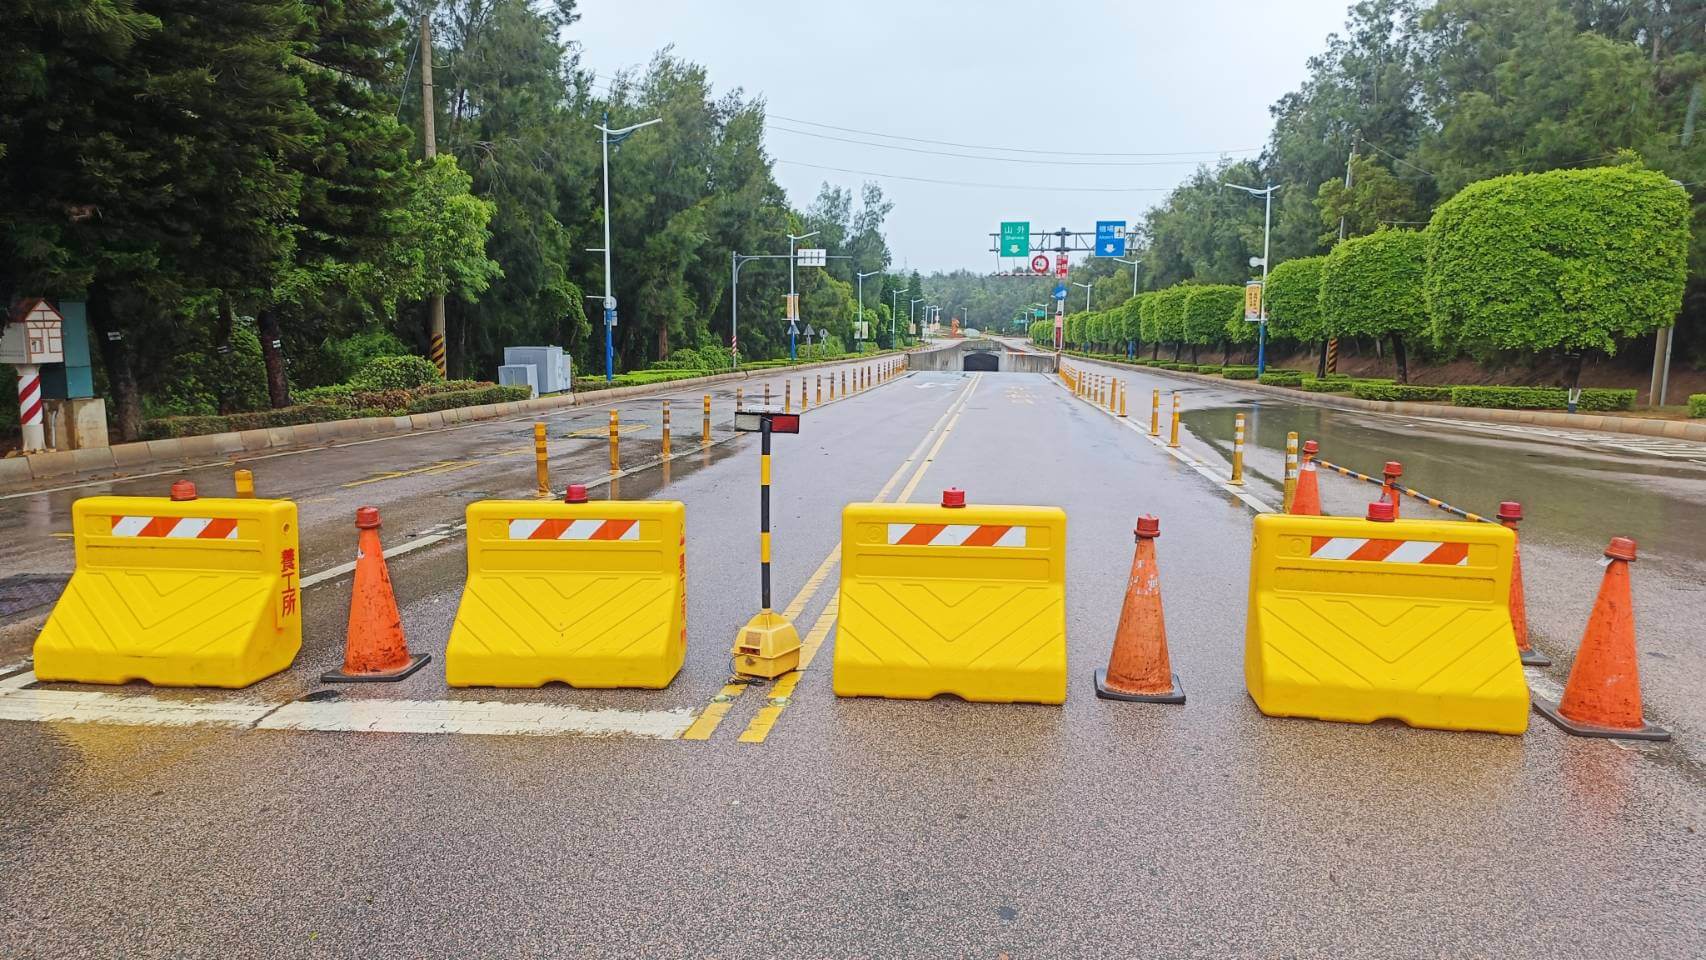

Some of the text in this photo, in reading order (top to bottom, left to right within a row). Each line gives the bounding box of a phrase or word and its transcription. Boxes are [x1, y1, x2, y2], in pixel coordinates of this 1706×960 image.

[1004, 225, 1025, 234] 山外
[281, 548, 296, 617] 養工所
